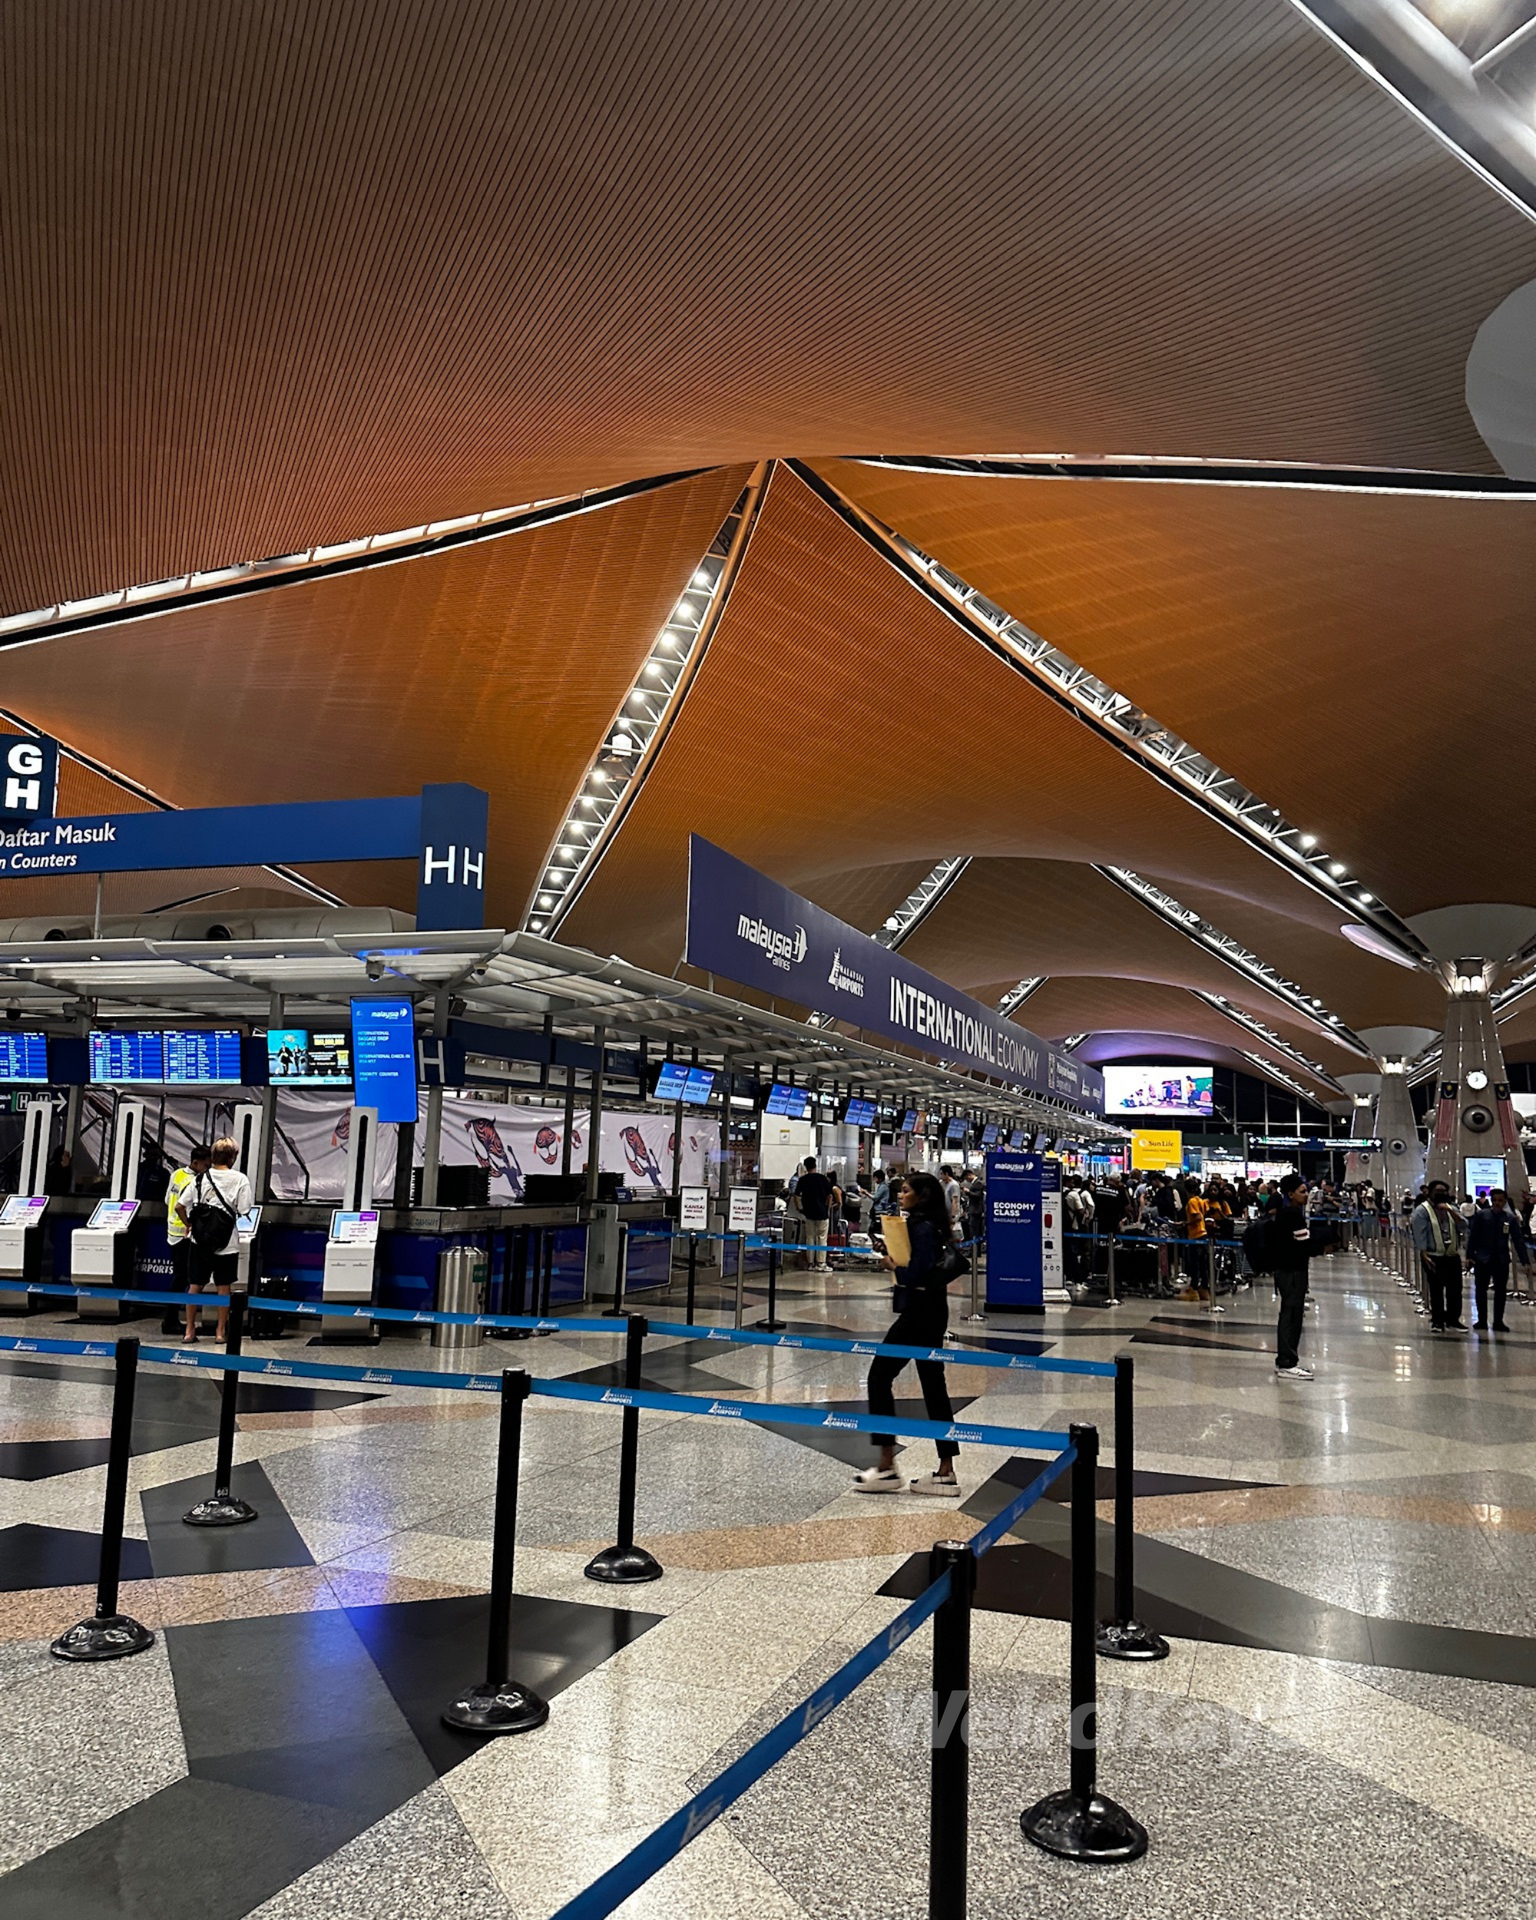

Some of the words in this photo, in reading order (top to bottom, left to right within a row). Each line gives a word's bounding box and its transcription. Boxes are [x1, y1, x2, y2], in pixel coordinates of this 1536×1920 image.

[7, 743, 43, 775] G
[5, 777, 40, 810] H
[55, 822, 117, 845] Masuk
[11, 853, 77, 869] Counters
[424, 845, 456, 885] H
[462, 846, 484, 890] H
[737, 914, 793, 959] malaysia
[839, 964, 865, 983] MALAYSIA
[837, 975, 864, 998] AIRPORTS
[889, 976, 995, 1065] INTERNATIONAL
[997, 1032, 1039, 1081] ECONOMY
[418, 1039, 445, 1083] H
[19, 1094, 28, 1109] H
[1162, 1139, 1174, 1147] Life
[994, 1162, 1025, 1172] malaysia
[993, 1202, 1035, 1211] ECONOMY
[993, 1209, 1020, 1217] CLASS
[831, 1421, 858, 1429] AIRPORTS
[954, 1433, 982, 1441] AIRPORTS
